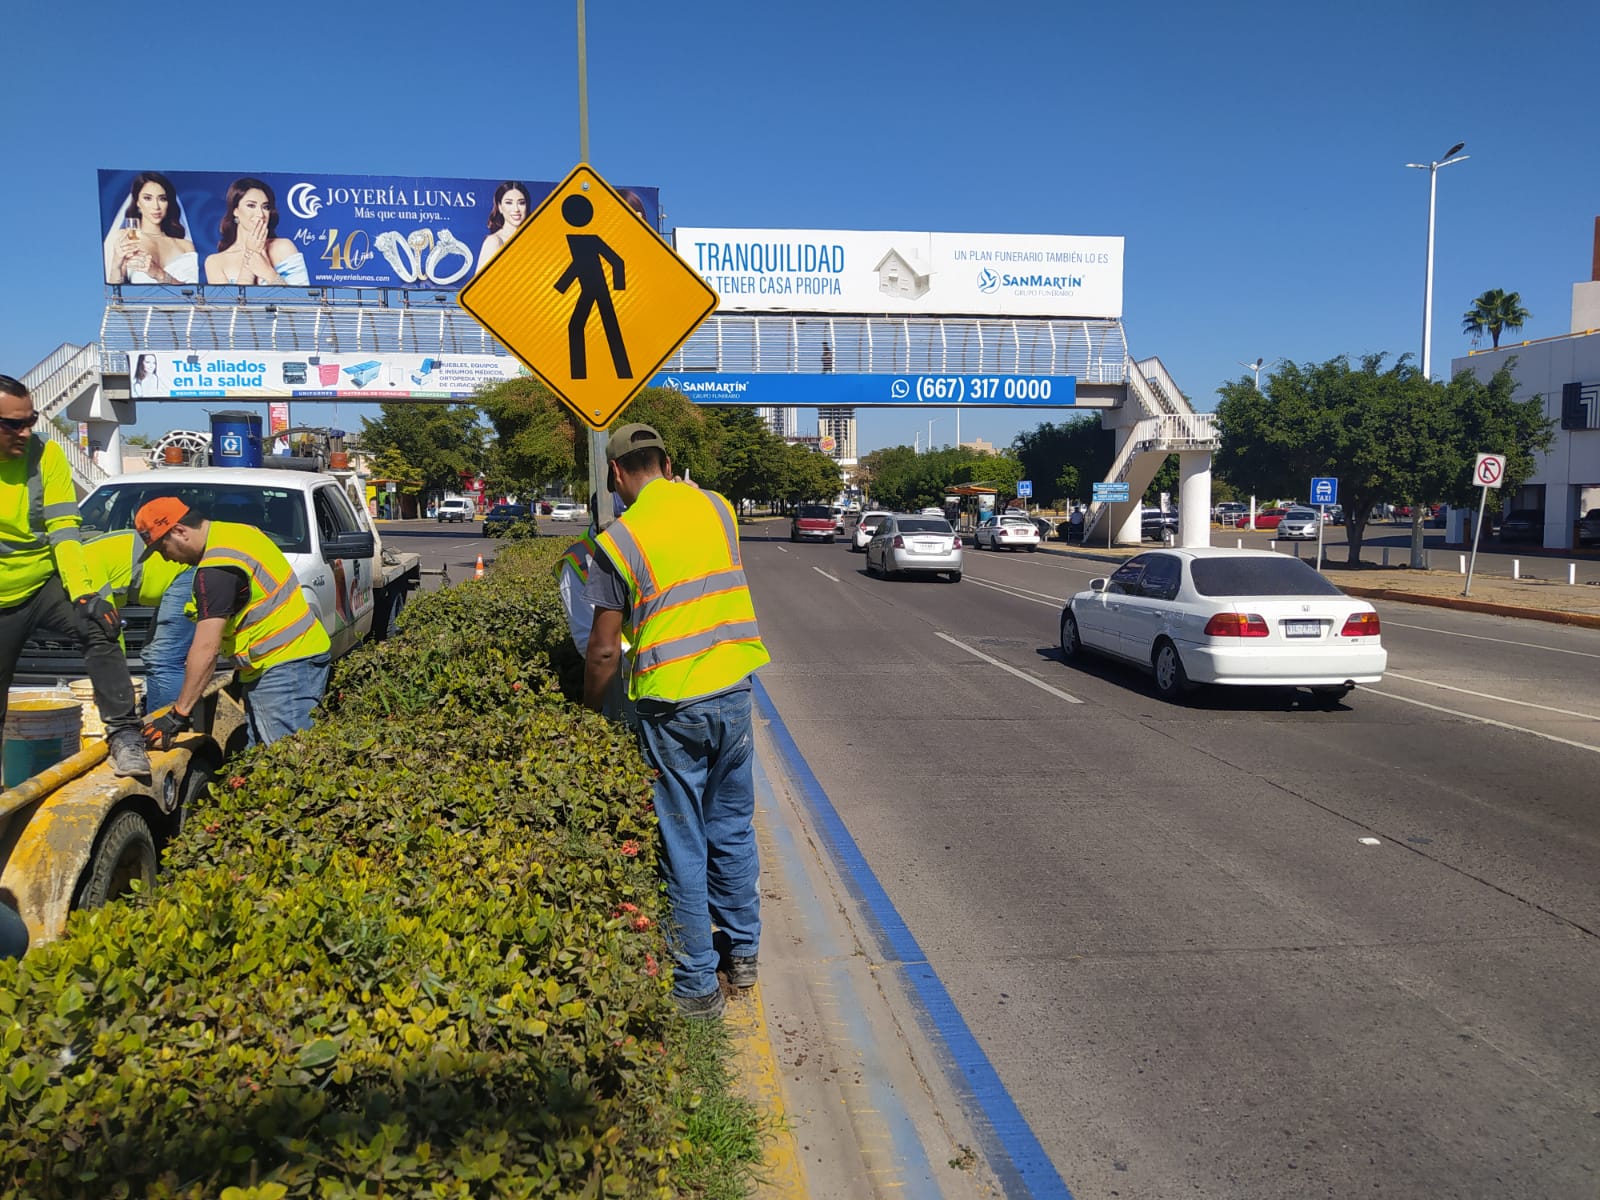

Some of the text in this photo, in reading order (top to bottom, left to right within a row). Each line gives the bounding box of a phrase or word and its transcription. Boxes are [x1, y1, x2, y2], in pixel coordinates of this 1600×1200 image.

[326, 185, 476, 208] JOYERÍA LUNAS
[354, 206, 375, 219] Más
[377, 210, 397, 222] que
[398, 210, 417, 220] una
[320, 228, 370, 271] 40
[694, 242, 845, 274] TRANQUILIDAD
[954, 250, 1109, 264] UN PLAN FUNERARIO TAMBIÉN LO ES
[716, 276, 756, 294] TENER
[759, 277, 792, 294] CASA
[796, 277, 841, 295] PROPIA
[172, 360, 267, 373] Tus aliados
[173, 374, 263, 388] en la salud
[916, 376, 1052, 402] (667) 317 0000
